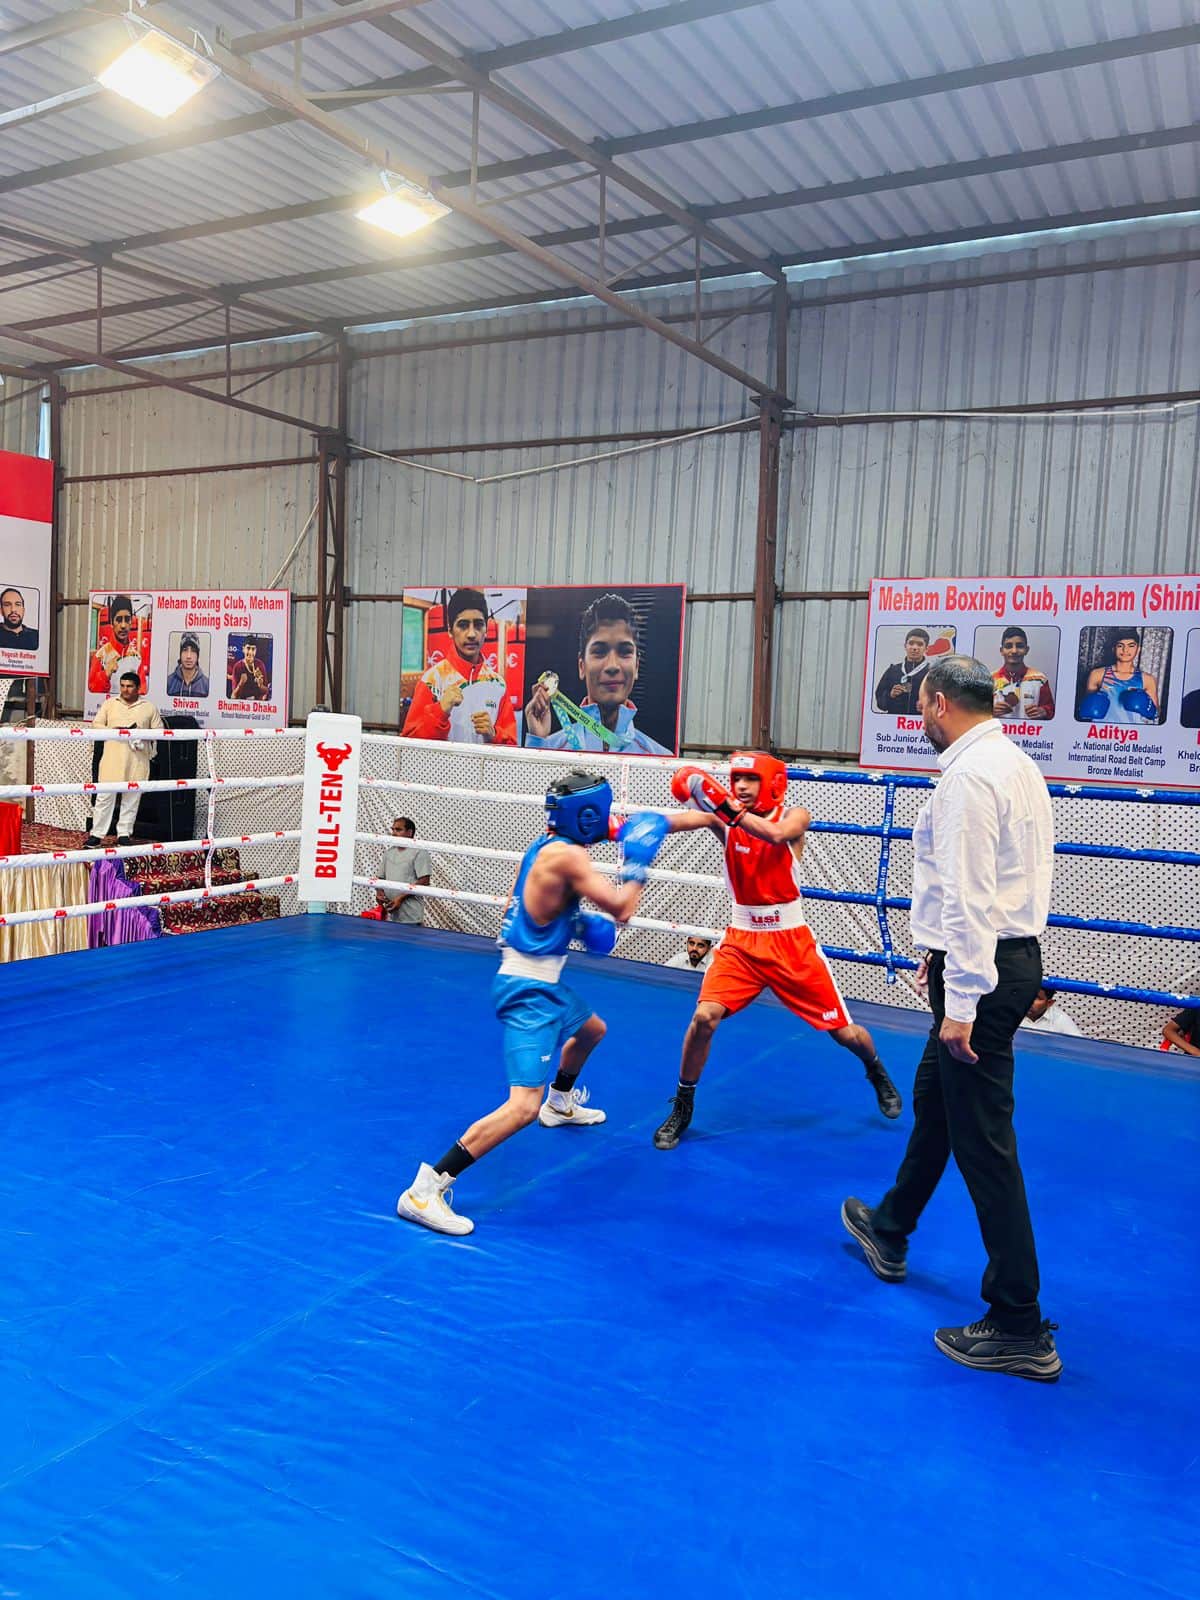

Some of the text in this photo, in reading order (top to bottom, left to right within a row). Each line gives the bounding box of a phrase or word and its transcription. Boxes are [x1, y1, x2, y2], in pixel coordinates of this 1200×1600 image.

[157, 596, 284, 612] Meham Boxing Club, Meham
[878, 586, 939, 611] Meham
[945, 585, 1006, 618] Boxing
[1012, 585, 1058, 616] Club,
[1065, 585, 1135, 611] Meham
[185, 613, 252, 630] (Shining Stars)
[173, 698, 199, 709] Shivan
[218, 700, 278, 714] Bhumika Dhaka
[897, 716, 925, 730] Rav
[1002, 721, 1043, 736] ander
[876, 733, 930, 743] Sub Junior As
[1087, 725, 1138, 744] Aditya
[878, 744, 938, 755] Bronze Medalis
[1022, 740, 1054, 749] Medalist
[1073, 741, 1163, 754] Jr. National Gold Medalist
[1068, 752, 1166, 768] Internatinal Road Belt Camp
[1088, 766, 1144, 777] Bronze Medalist
[315, 773, 343, 878] BULL-TEN
